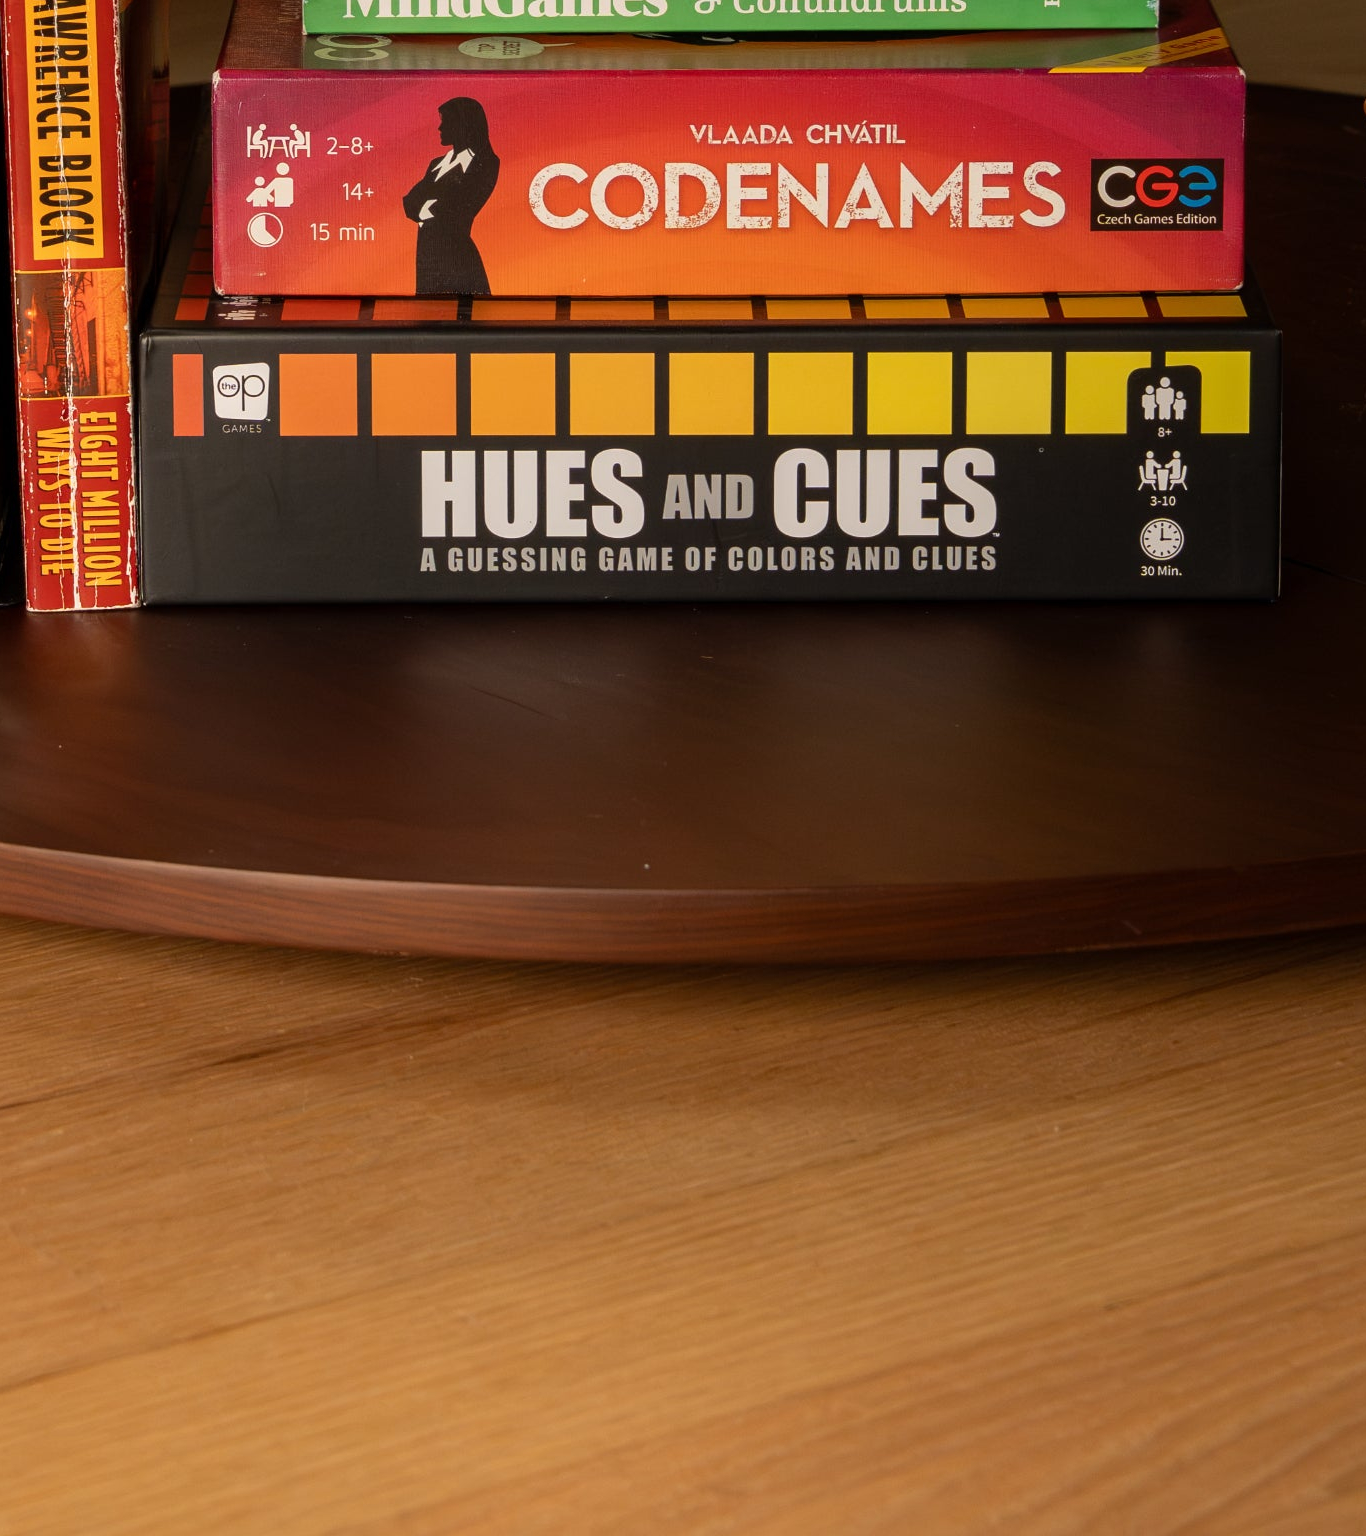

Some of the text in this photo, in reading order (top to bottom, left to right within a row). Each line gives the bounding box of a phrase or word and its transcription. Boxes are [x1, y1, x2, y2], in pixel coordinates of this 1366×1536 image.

[689, 120, 906, 144] VLAADA CHVÁTIL
[342, 183, 374, 200] 14+
[529, 162, 1067, 230] CODENAMES
[37, 156, 95, 248] BLOCK
[1097, 213, 1217, 225] Czech Games Edition
[310, 223, 375, 240] 15 min
[221, 382, 237, 390] the
[222, 424, 262, 434] GAMES
[1157, 427, 1173, 438] 8+
[36, 426, 76, 576] WAYS TO DIE
[79, 411, 123, 587] EIGHT MILLION
[421, 448, 997, 538] HUES AND CUES
[1149, 496, 1177, 506] 3-10
[420, 546, 997, 572] A GUESSING GAME OF COLORS AND CLUES
[1141, 565, 1183, 576] 30 Min.
